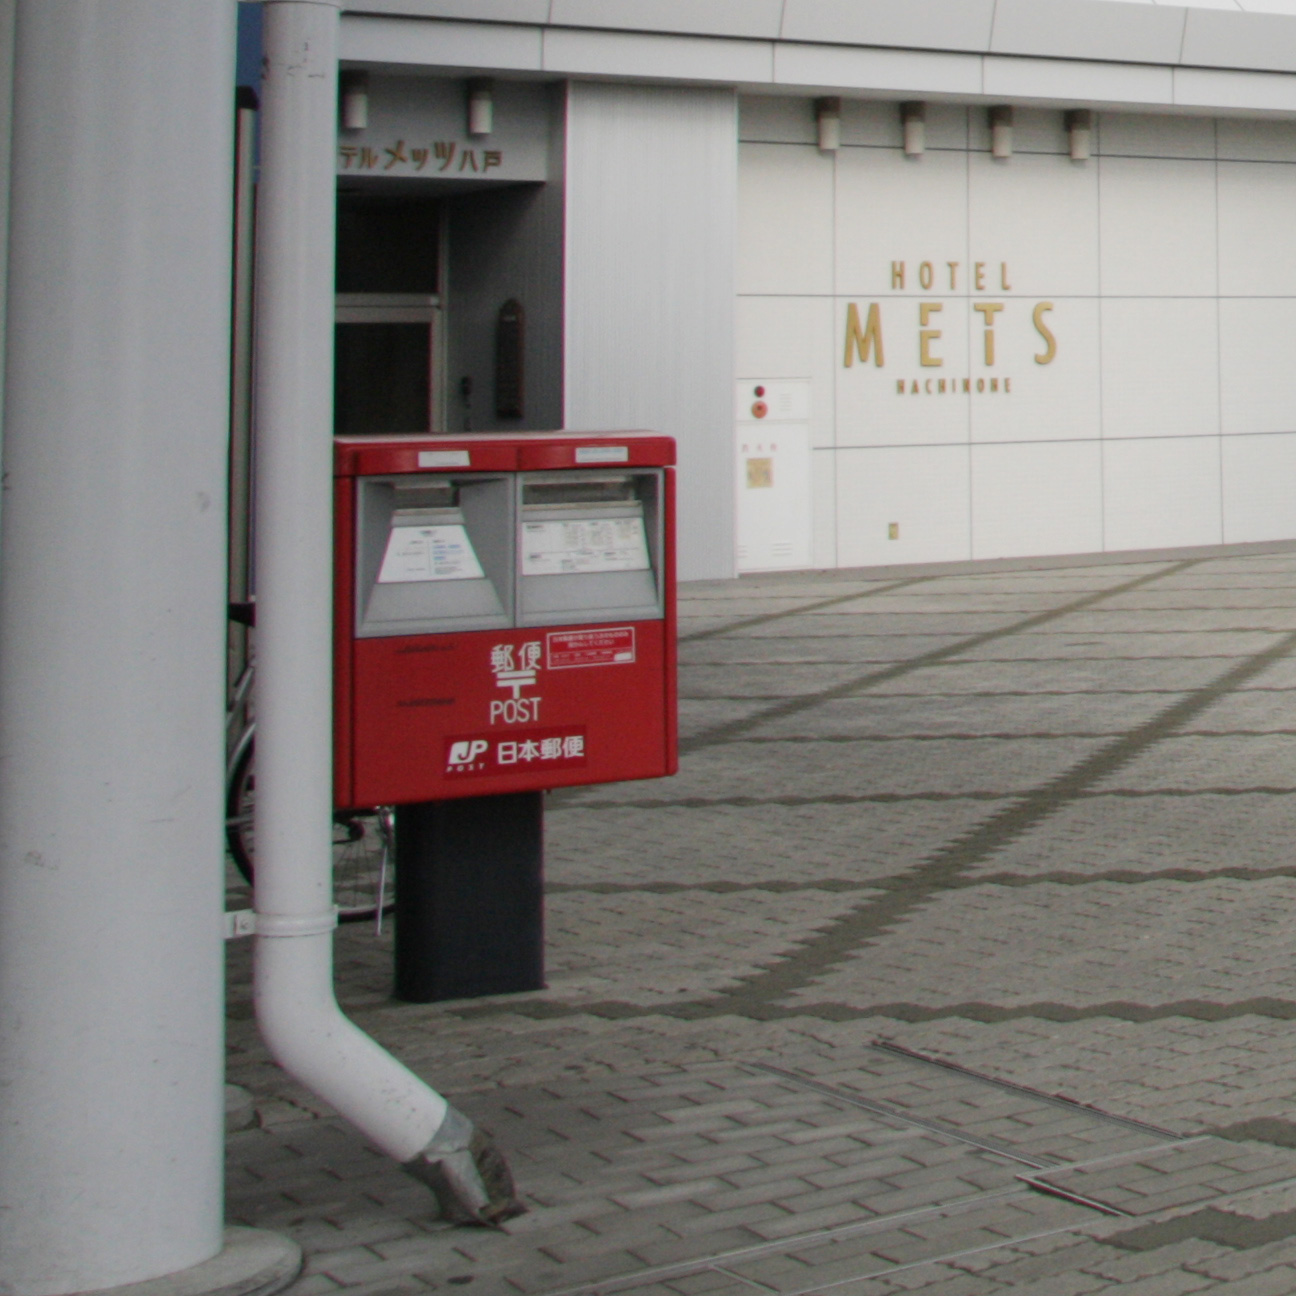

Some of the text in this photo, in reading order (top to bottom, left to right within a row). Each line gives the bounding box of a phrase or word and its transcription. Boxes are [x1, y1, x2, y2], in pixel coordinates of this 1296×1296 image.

[339, 140, 503, 172] テルメッツ八戸
[890, 260, 1012, 291] HOTEL
[844, 301, 1057, 368] METS
[896, 377, 1012, 395] HACHINOHE
[490, 641, 542, 673] 郵便
[490, 696, 542, 725] POST
[497, 735, 585, 765] 日本郵便
